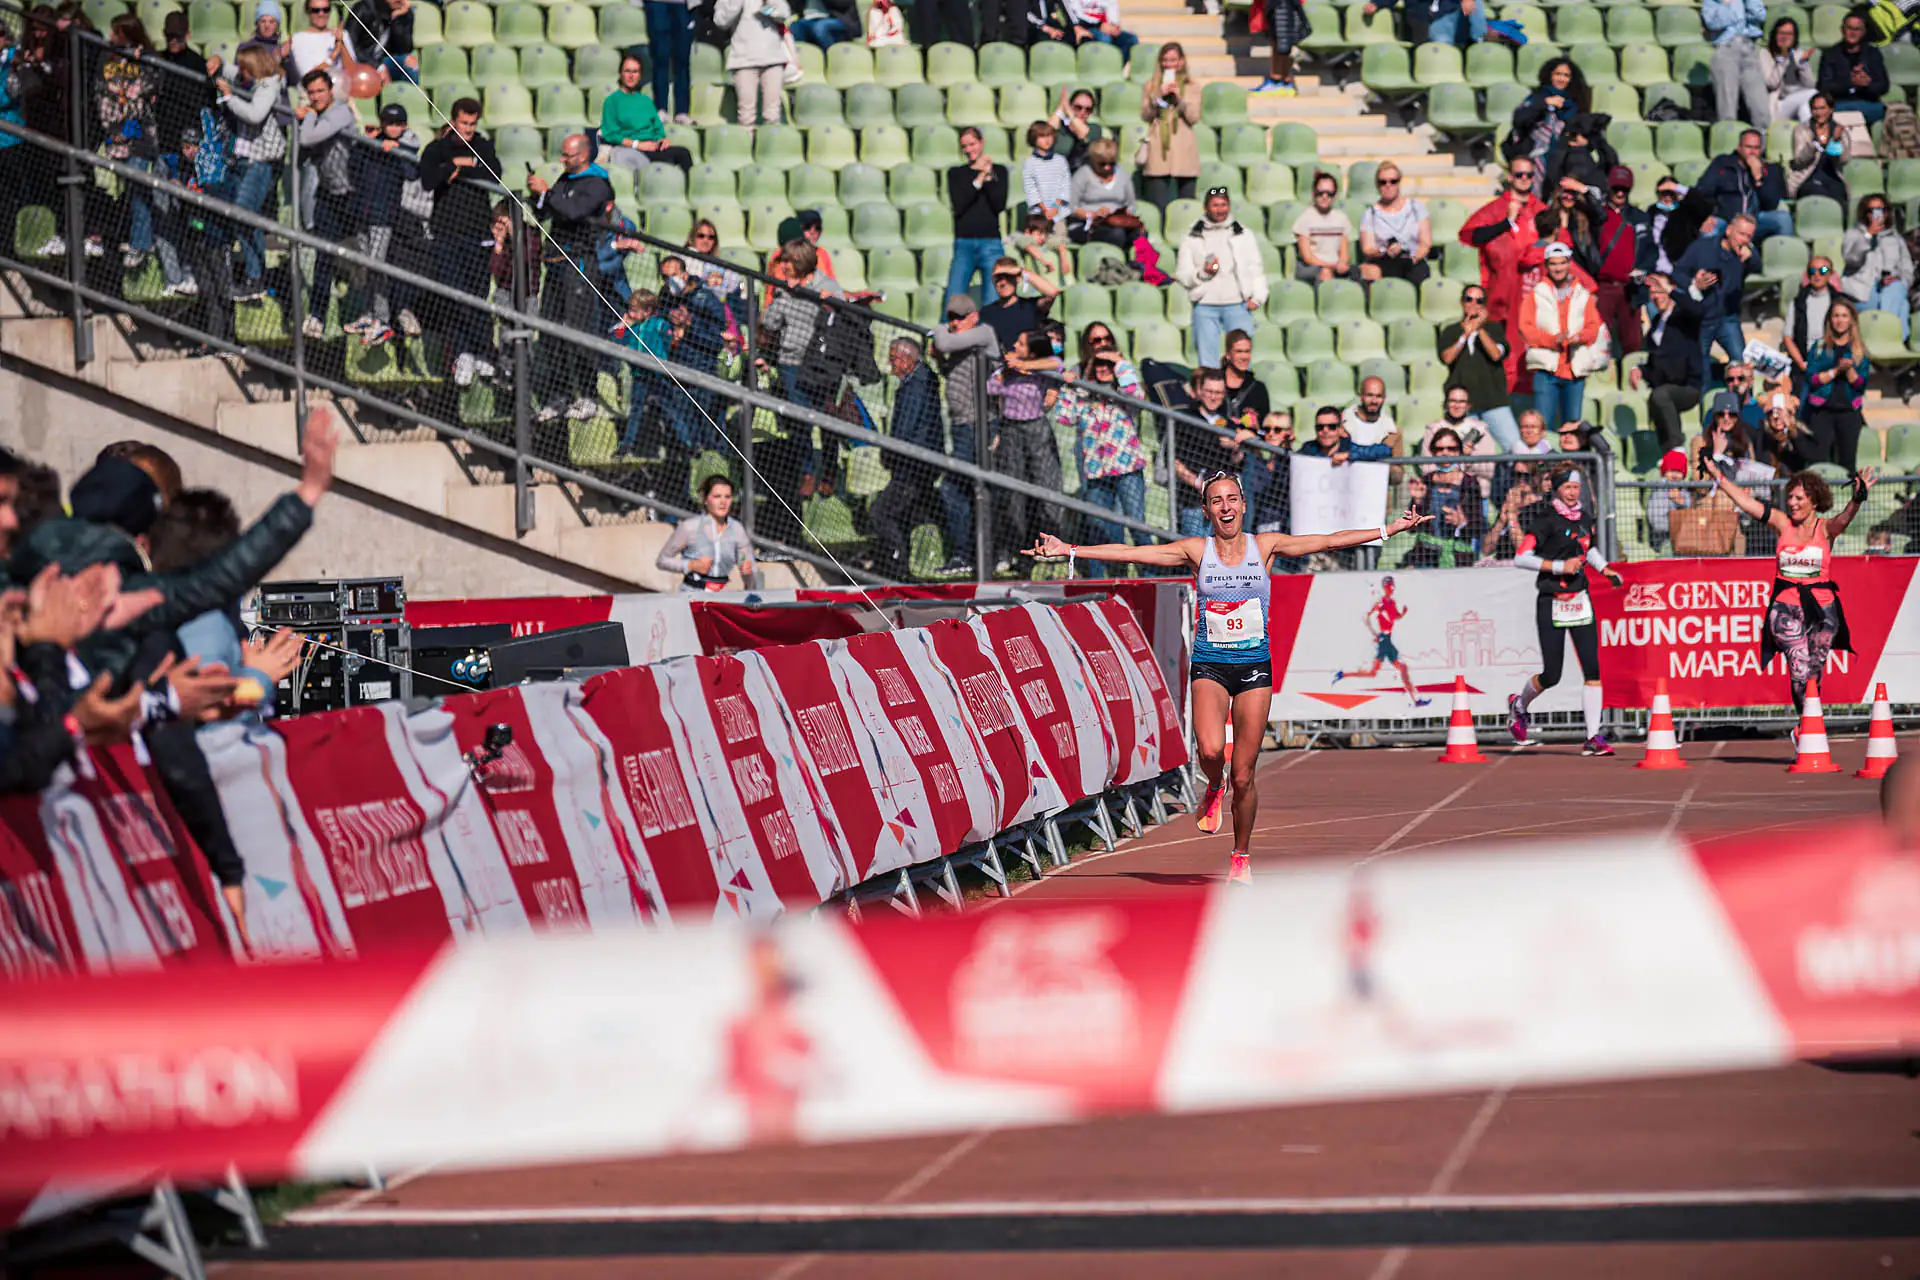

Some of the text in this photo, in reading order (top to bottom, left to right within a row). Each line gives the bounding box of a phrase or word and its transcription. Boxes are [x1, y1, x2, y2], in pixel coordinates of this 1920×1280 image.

[1668, 580, 1770, 610] GENER
[1226, 617, 1243, 631] 93
[1669, 648, 1848, 678] MARAN
